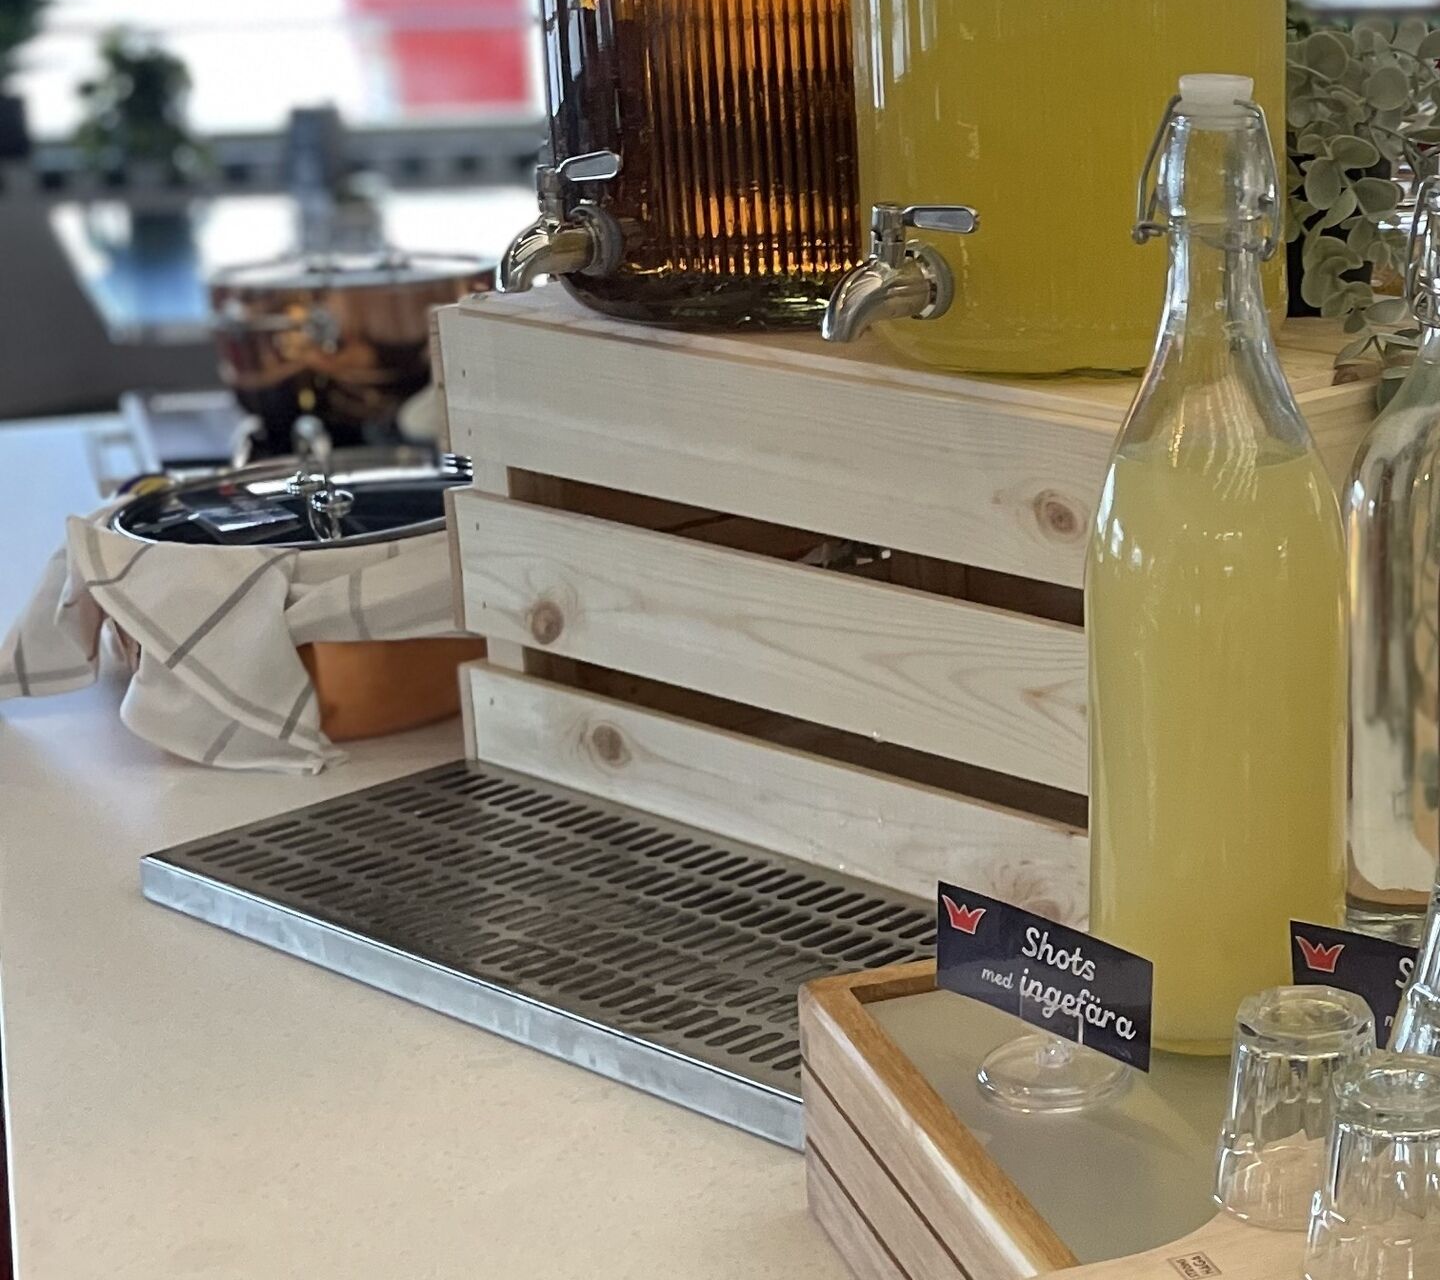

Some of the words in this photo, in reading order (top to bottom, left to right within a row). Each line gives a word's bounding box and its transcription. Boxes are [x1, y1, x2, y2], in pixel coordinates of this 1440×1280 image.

[1021, 926, 1096, 982] Shots
[982, 968, 1014, 990] med
[1019, 968, 1137, 1040] ingefära
